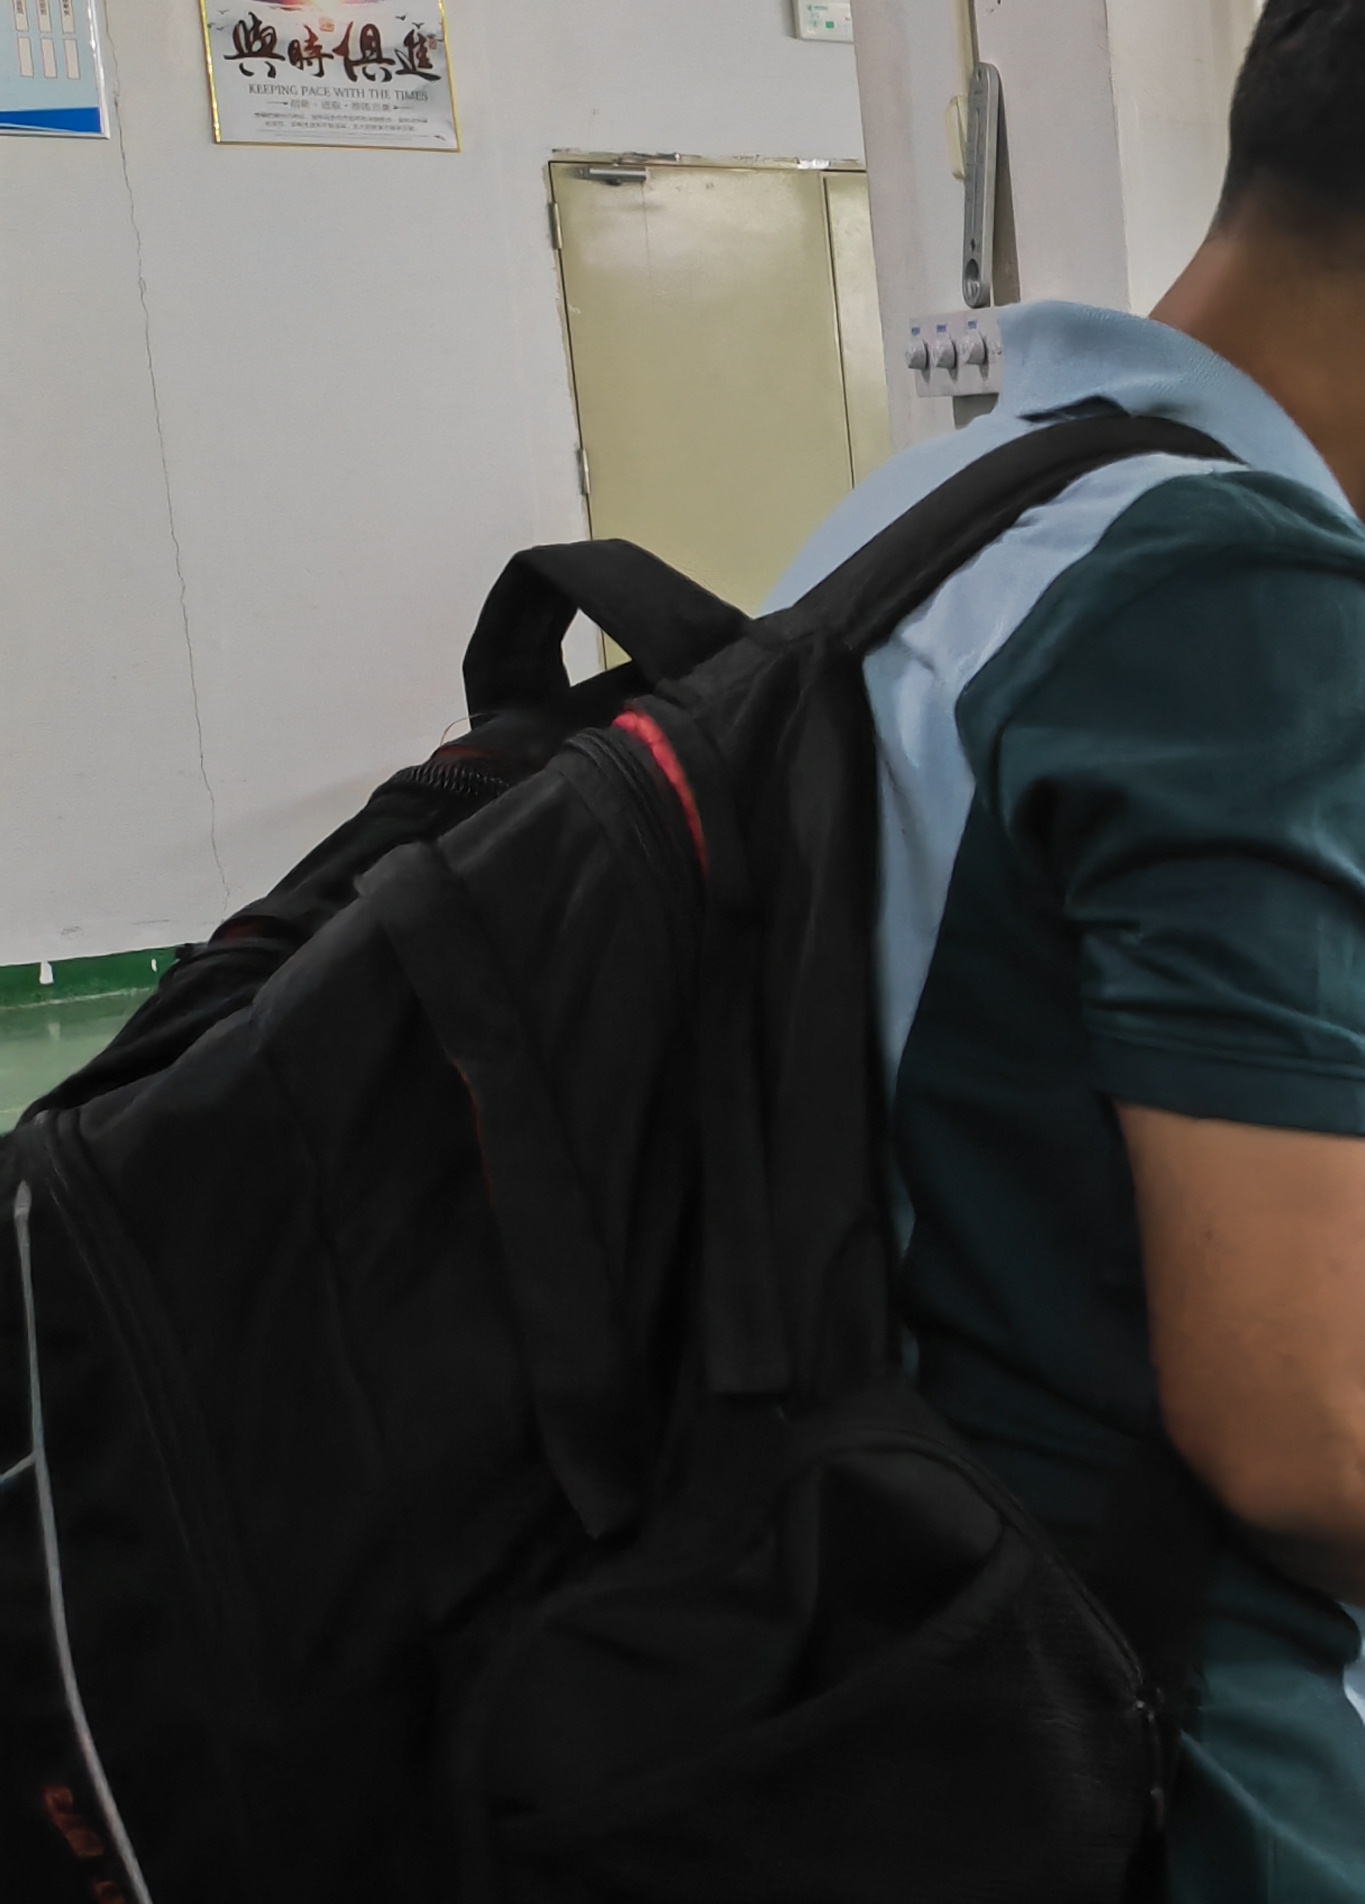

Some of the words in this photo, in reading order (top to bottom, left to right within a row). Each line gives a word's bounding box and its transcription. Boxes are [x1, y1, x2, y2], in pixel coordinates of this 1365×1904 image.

[223, 12, 441, 82] 與時俱進
[248, 83, 298, 96] KEEPING
[301, 86, 330, 97] PACE
[331, 87, 365, 98] WITH
[368, 88, 390, 100] THE
[394, 89, 429, 101] TIMES
